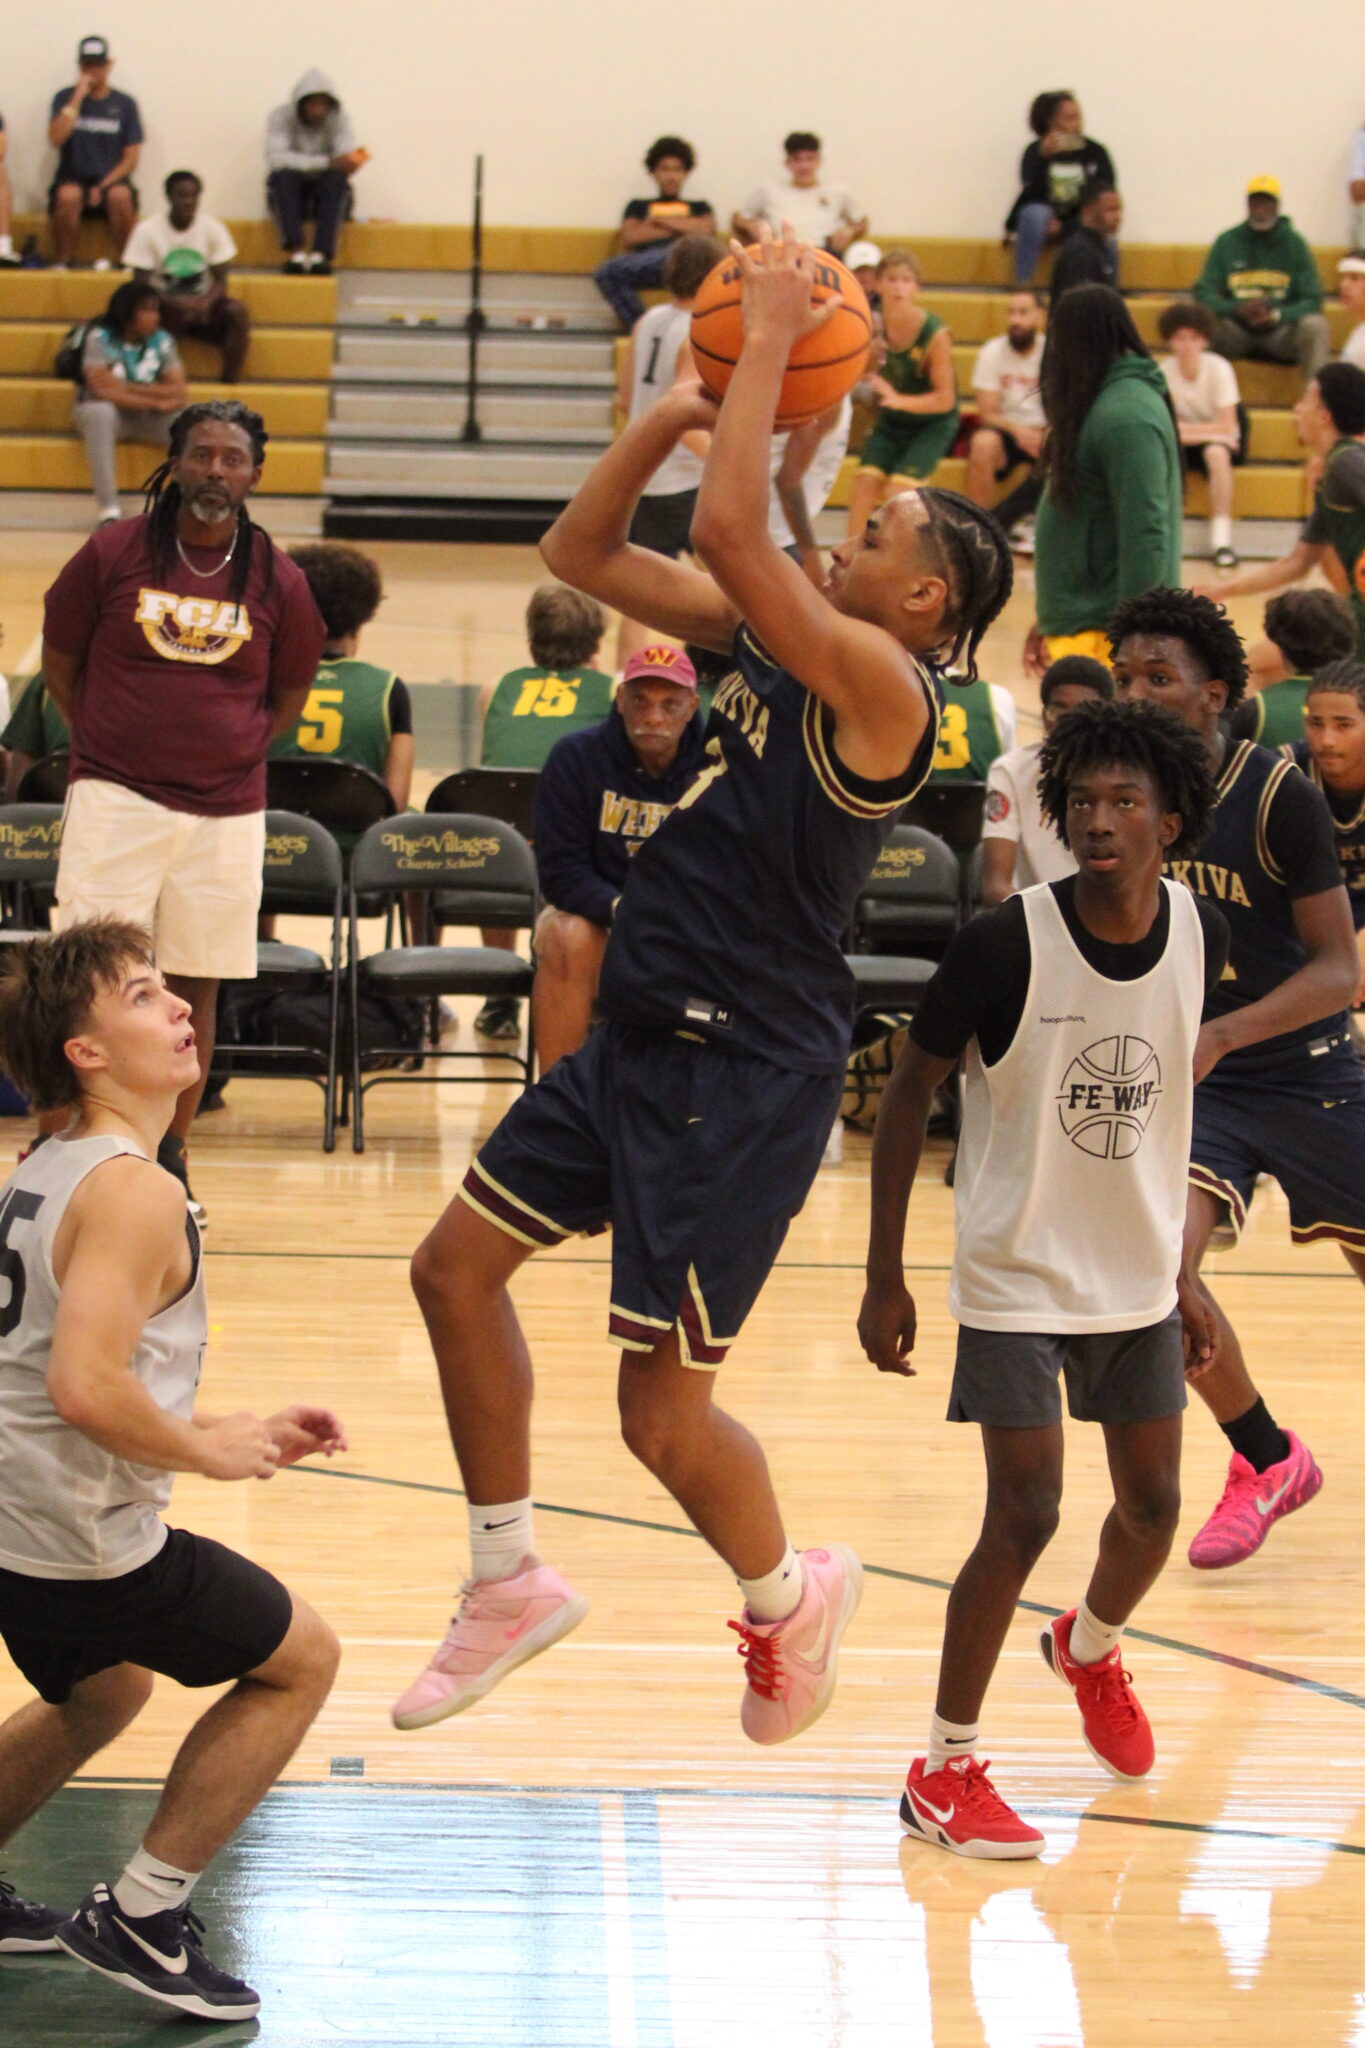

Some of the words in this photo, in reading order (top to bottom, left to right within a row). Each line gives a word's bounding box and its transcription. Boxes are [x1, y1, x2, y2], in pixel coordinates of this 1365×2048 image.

[642, 336, 662, 385] 1
[136, 589, 252, 639] FCA
[643, 648, 679, 667] W
[512, 676, 582, 718] 15
[297, 689, 344, 754] 5
[265, 832, 309, 854] ages
[381, 833, 420, 857] The
[421, 830, 501, 858] Villages
[396, 857, 442, 870] Charter
[444, 856, 486, 870] School
[1162, 860, 1252, 907] KIVA
[716, 1010, 728, 1022] M
[0, 1186, 46, 1338] 5
